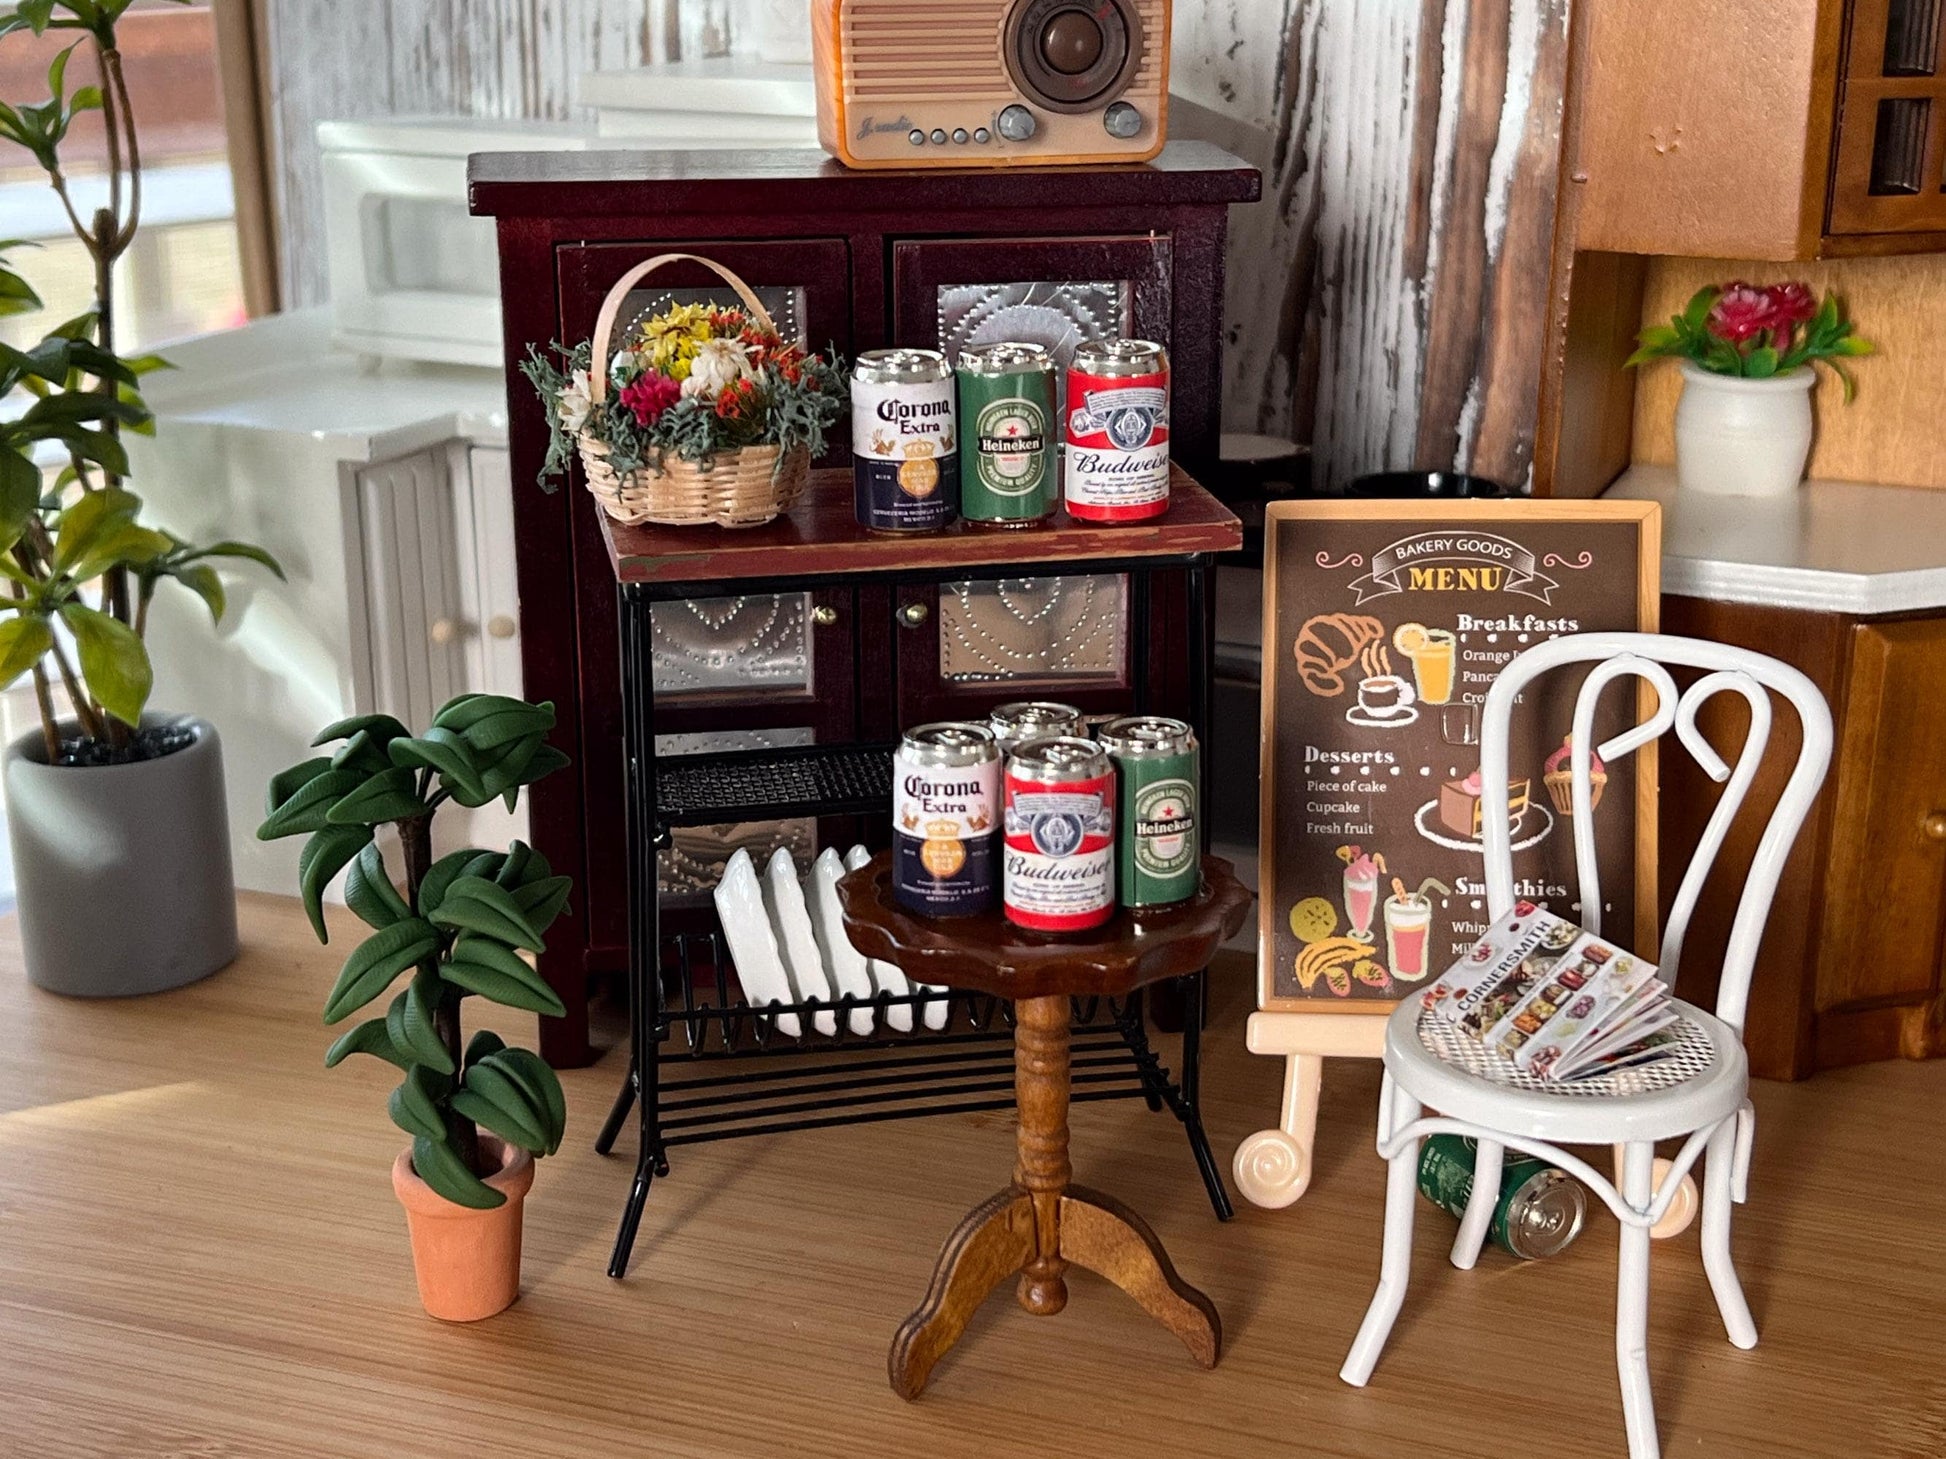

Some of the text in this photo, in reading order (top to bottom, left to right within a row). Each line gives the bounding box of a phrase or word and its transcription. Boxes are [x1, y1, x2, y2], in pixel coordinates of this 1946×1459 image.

[877, 398, 952, 425] Corona
[900, 419, 940, 435] Extra
[982, 439, 1040, 451] Heineken
[1073, 452, 1168, 474] Budweise
[1395, 539, 1513, 560] BAKERY GOODS
[1408, 567, 1502, 591] MENU
[1456, 614, 1579, 632] Breakfasts
[1463, 650, 1510, 664] Orange
[1304, 745, 1395, 763] Desserts
[904, 774, 983, 800] Corona
[1307, 780, 1387, 792] Piece of cake
[922, 798, 967, 813] Extra
[1306, 801, 1360, 815] Cupcake
[1136, 818, 1193, 835] Heineken
[1306, 822, 1374, 834] Fresh fruit
[1006, 850, 1111, 880] Budweiser
[1455, 876, 1567, 896] Smthies
[1457, 920, 1551, 1012] CORNERSMITH
